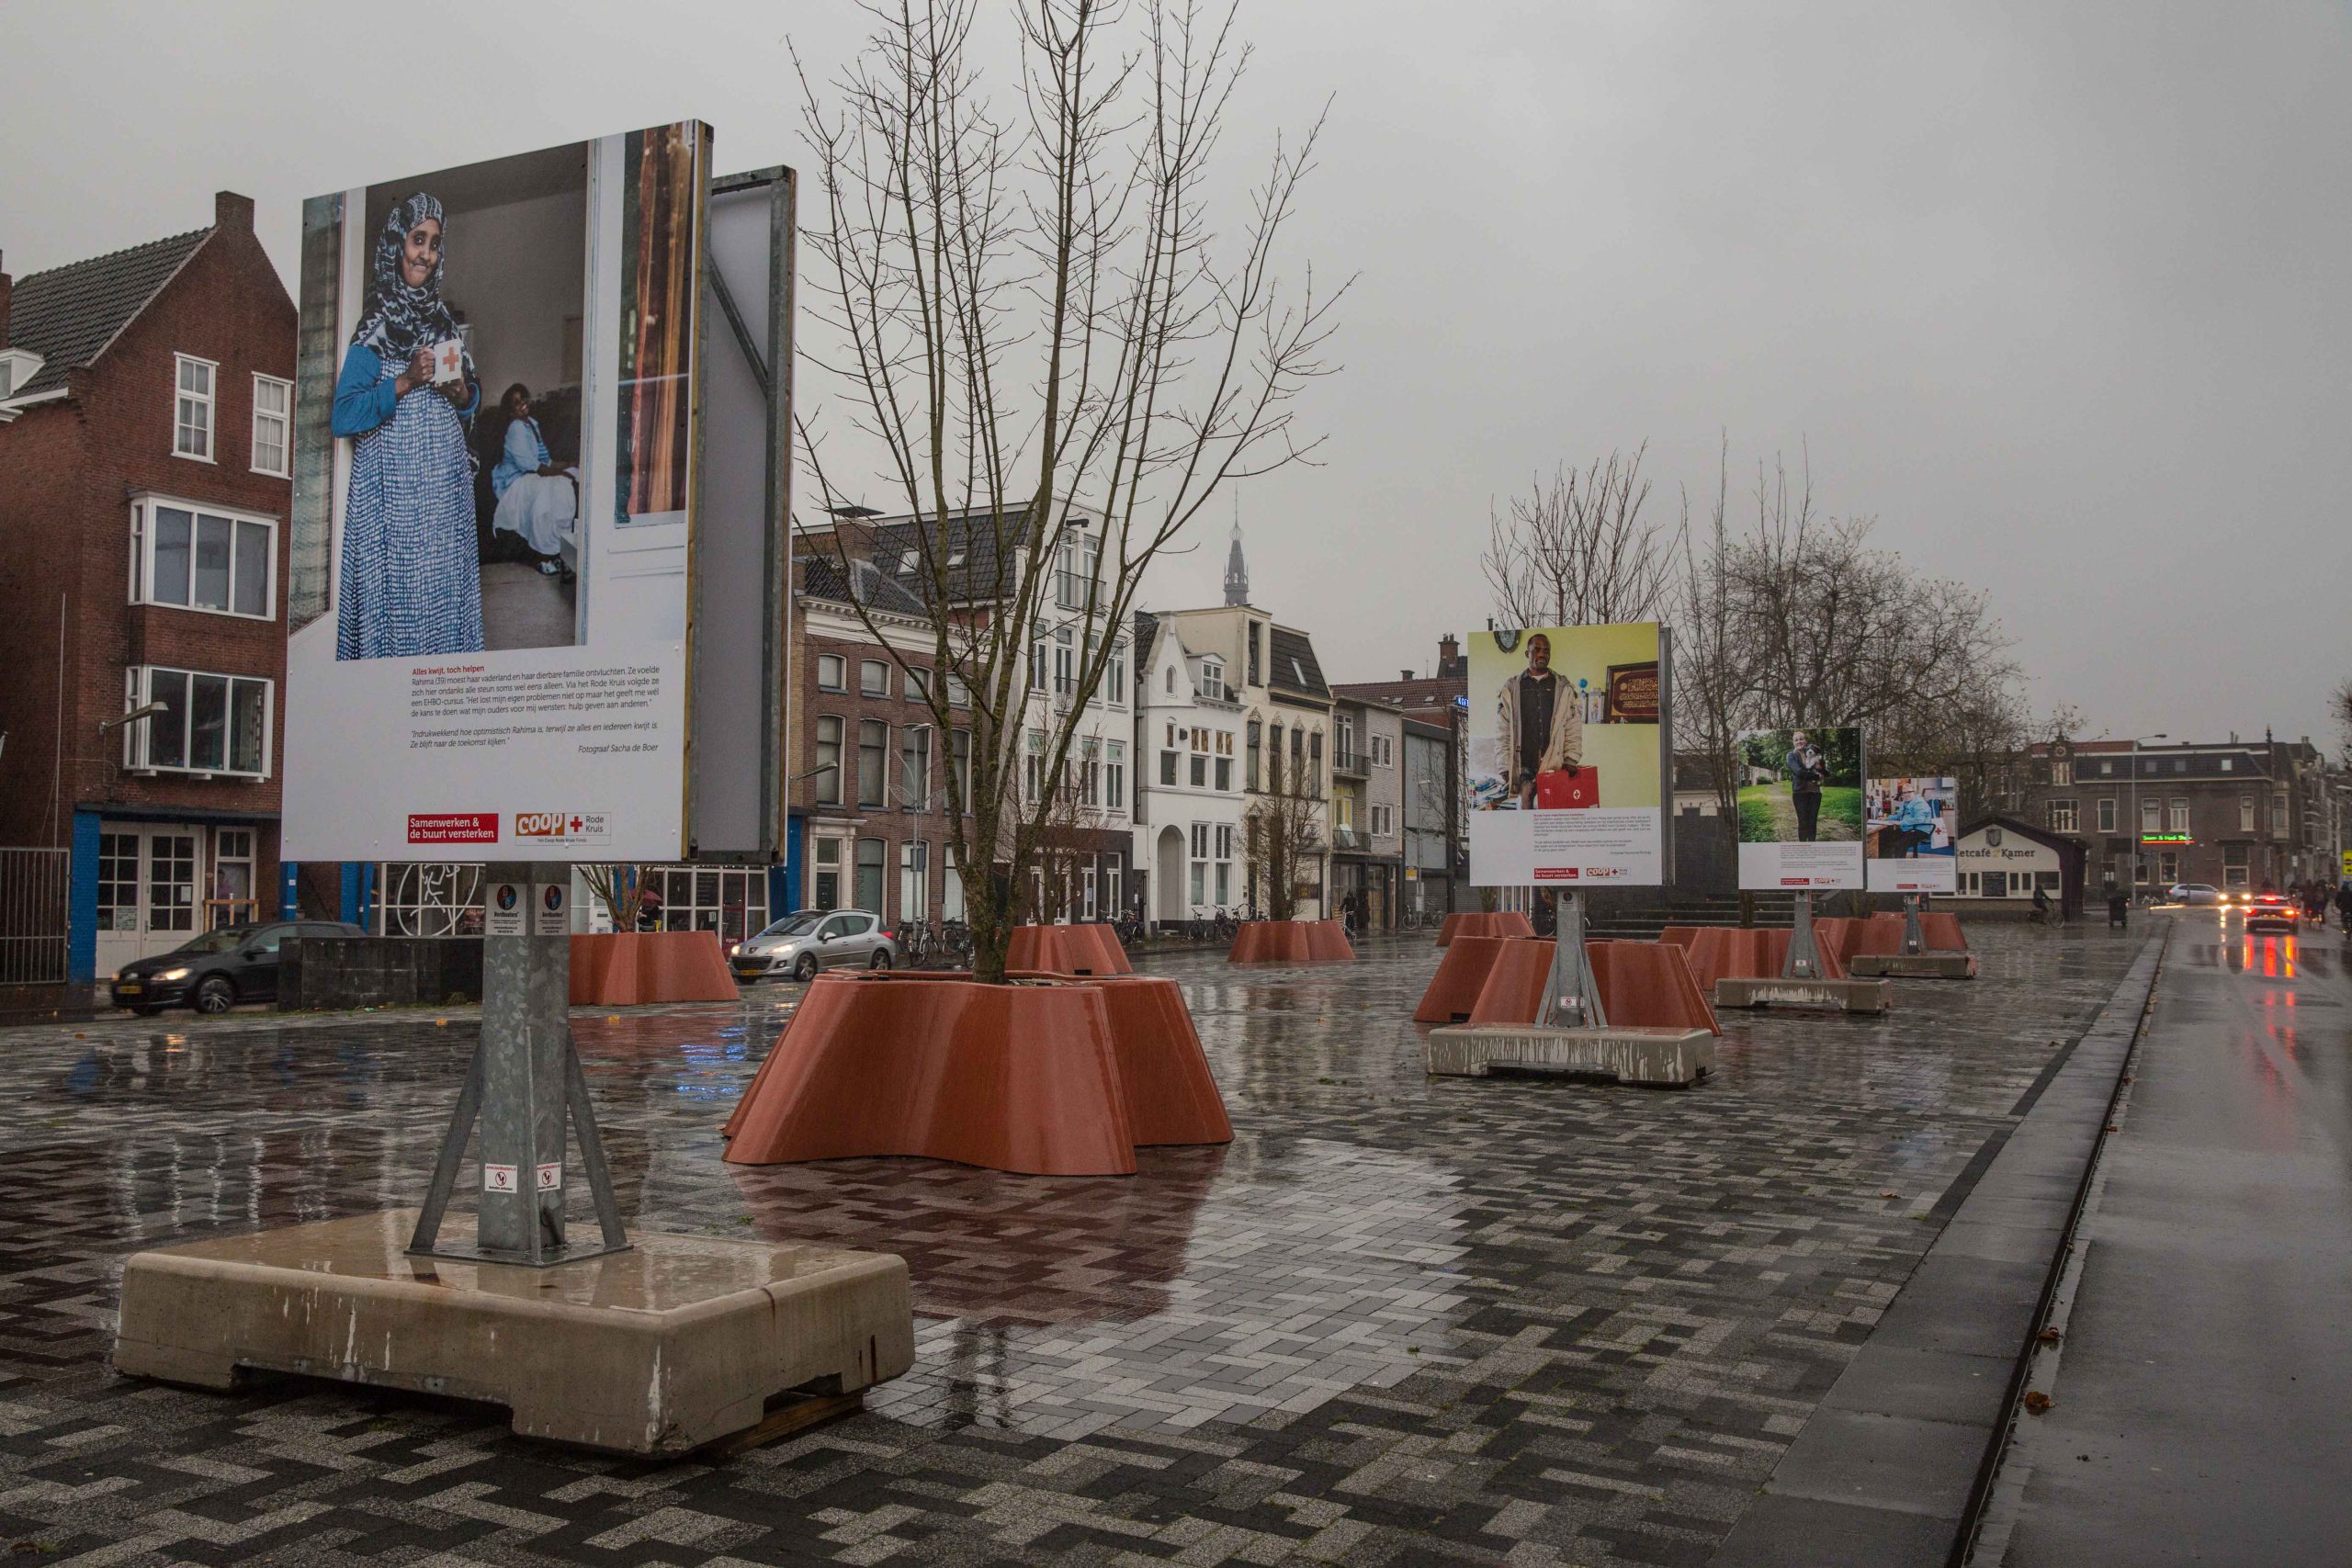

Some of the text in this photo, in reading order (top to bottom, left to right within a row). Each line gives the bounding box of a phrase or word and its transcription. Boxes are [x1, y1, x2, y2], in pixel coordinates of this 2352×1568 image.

[463, 665, 485, 673] helpen
[537, 671, 562, 680] dierbare
[563, 670, 584, 678] familie
[591, 679, 607, 687] Rode
[609, 678, 626, 686] Kruis
[628, 677, 650, 686] volgde
[507, 695, 525, 704] eigen
[526, 693, 560, 702] problemen
[562, 691, 574, 699] niet
[616, 689, 633, 698] geeft
[443, 707, 458, 716] doen
[472, 707, 486, 716] mijn
[488, 705, 508, 714] ouders
[526, 704, 537, 713] mij
[569, 701, 583, 711] hulp
[585, 702, 605, 711] geven
[473, 728, 510, 736] optimistisch
[513, 726, 536, 734] Rahima
[546, 724, 566, 733] terwijl
[603, 722, 632, 730] iedereen
[634, 721, 650, 730] kwijt
[419, 740, 433, 749] blijft
[579, 745, 609, 754] Fotograaf
[611, 744, 630, 752] Sacha
[410, 818, 480, 828] Samenwerken &
[518, 813, 563, 835] coop
[586, 816, 605, 824] Rode
[410, 829, 494, 838] de buurt versterken
[1957, 848, 1991, 858] etcafé
[2001, 849, 2035, 860] Kamer
